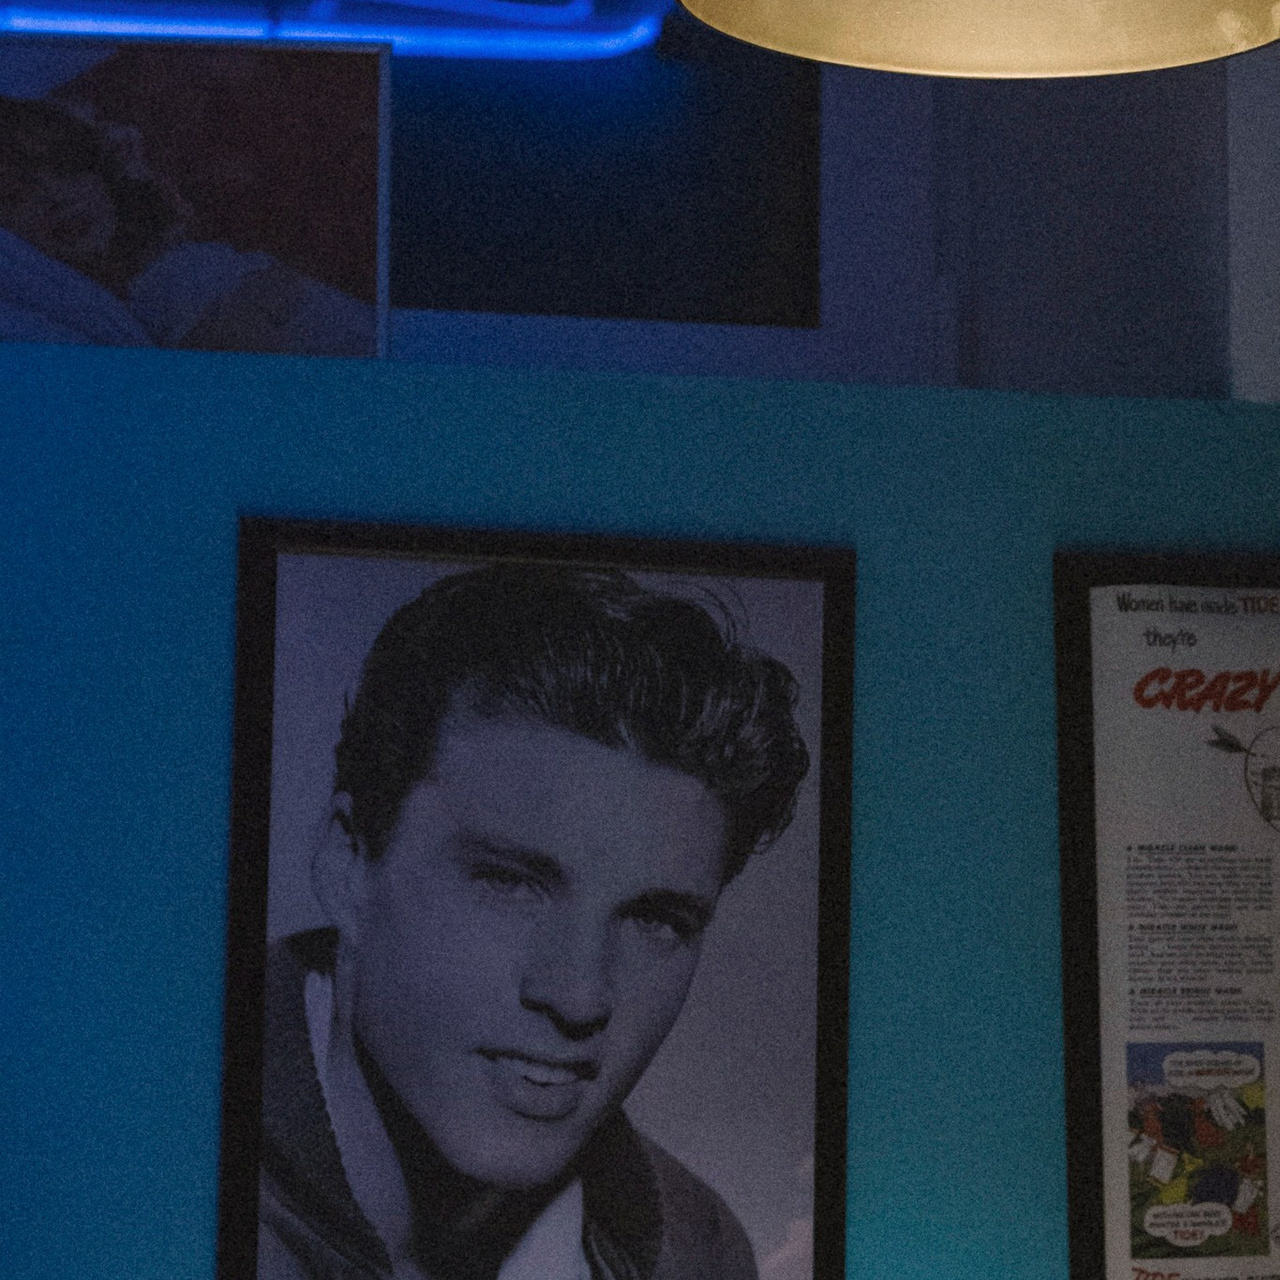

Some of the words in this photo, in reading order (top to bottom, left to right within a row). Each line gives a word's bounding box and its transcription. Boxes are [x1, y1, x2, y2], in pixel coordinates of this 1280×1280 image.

[1116, 592, 1164, 614] Women
[1168, 595, 1198, 614] have
[1238, 595, 1280, 617] TIDE
